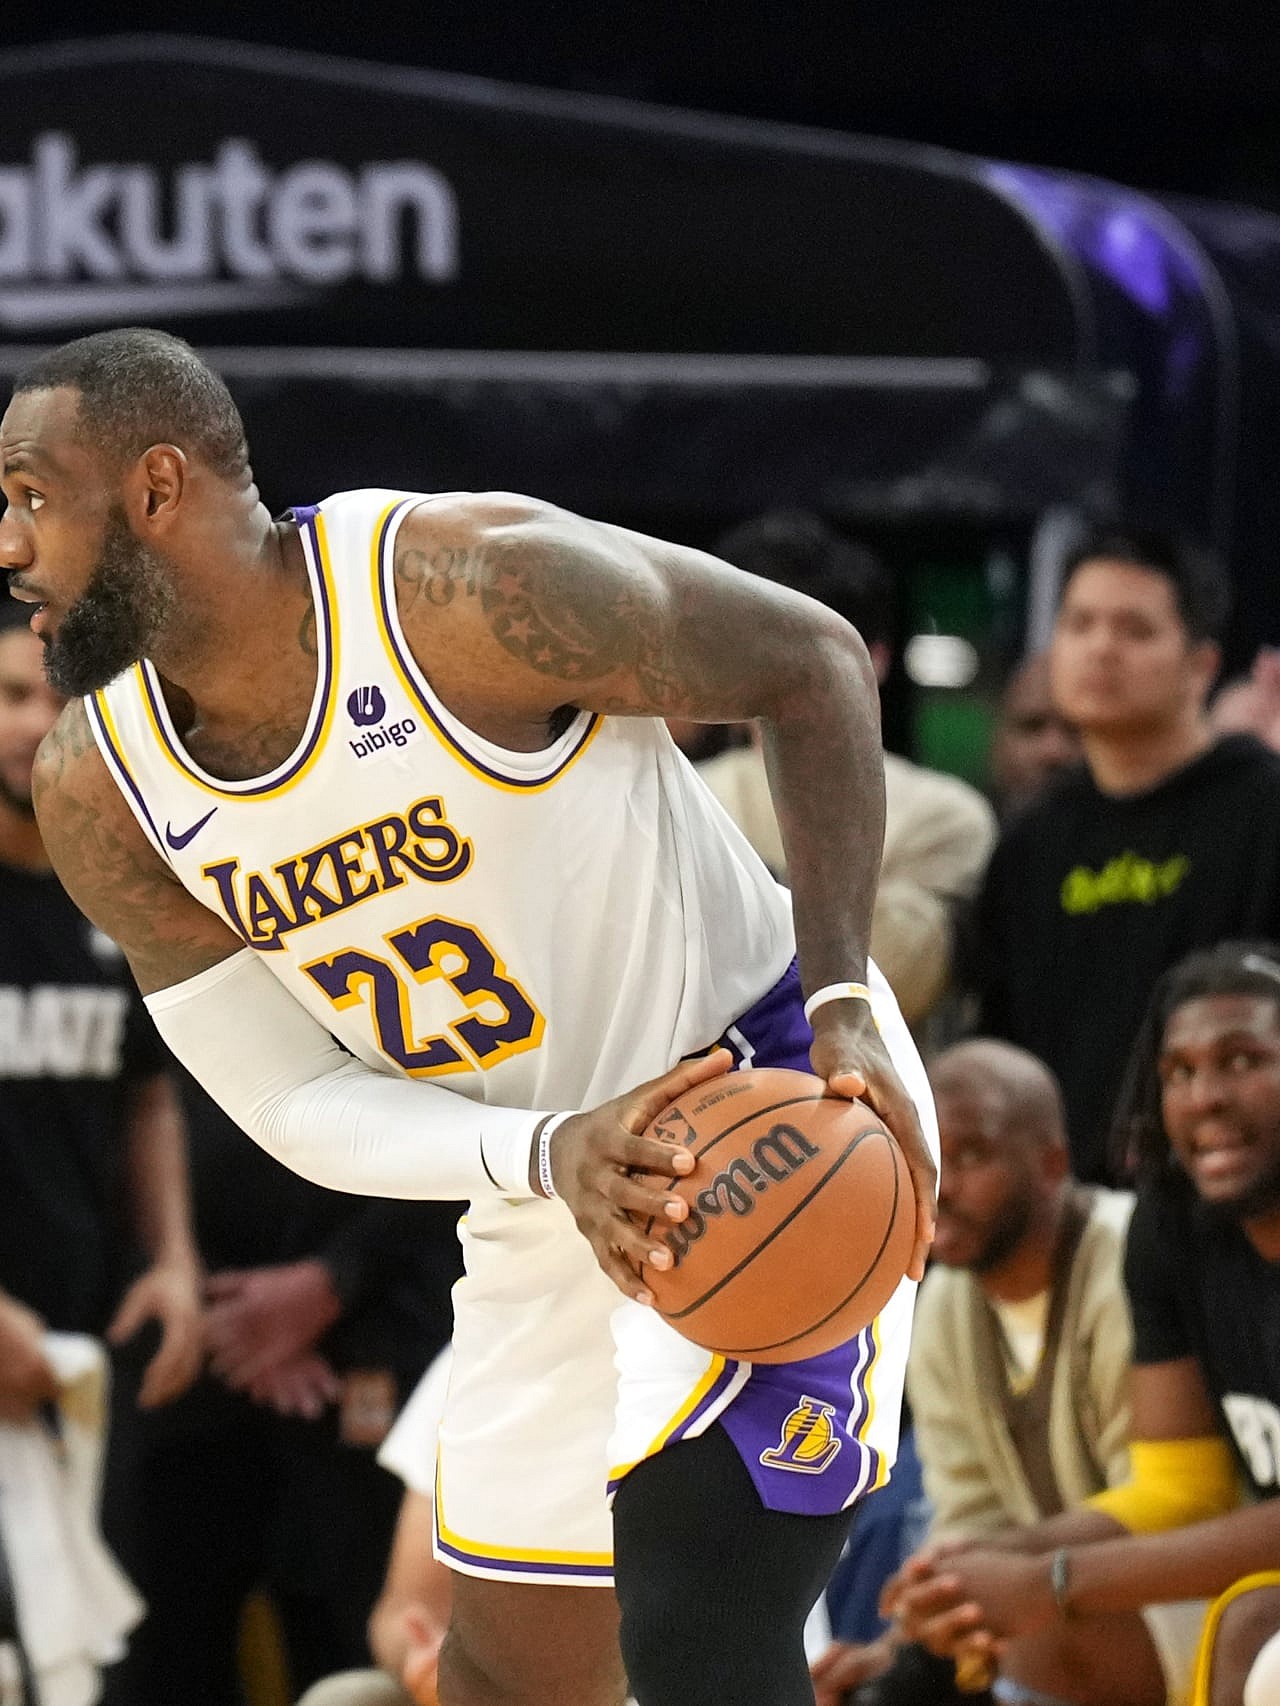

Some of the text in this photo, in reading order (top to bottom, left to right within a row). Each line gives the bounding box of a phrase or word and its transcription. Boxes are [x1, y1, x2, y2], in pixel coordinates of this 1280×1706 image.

[349, 718, 417, 759] bibigo
[200, 795, 475, 953] LAKERS
[298, 913, 547, 1081] 23
